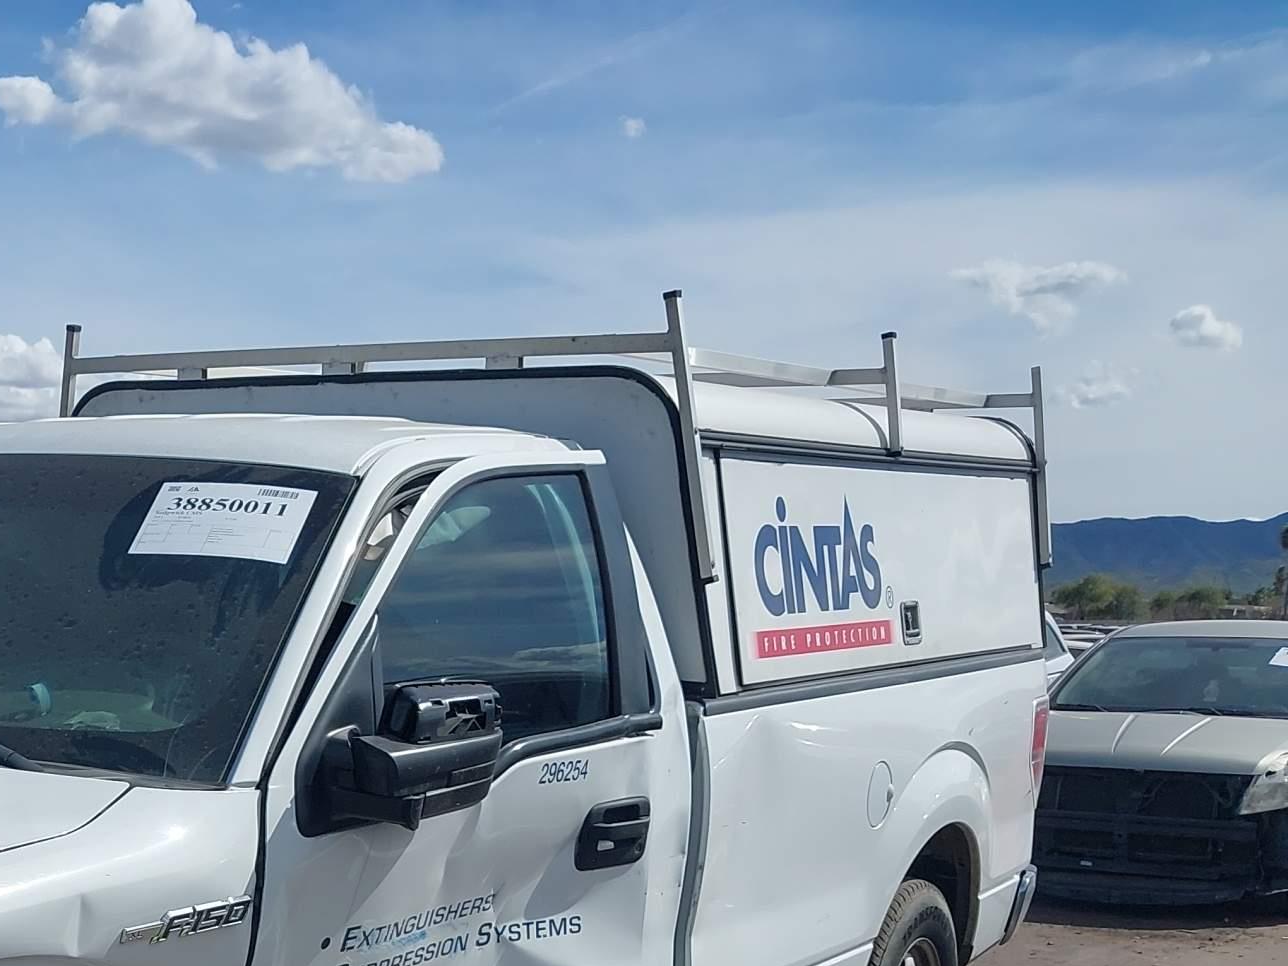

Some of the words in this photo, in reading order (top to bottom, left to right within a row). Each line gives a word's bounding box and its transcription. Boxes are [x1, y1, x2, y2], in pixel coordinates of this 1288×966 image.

[166, 497, 289, 517] 38850011
[764, 633, 797, 653] FIRE
[805, 624, 887, 648] PROTECTION
[538, 759, 589, 785] 296254
[340, 893, 495, 953] EXTINGUISHERS
[475, 914, 583, 948] SYSTEMS
